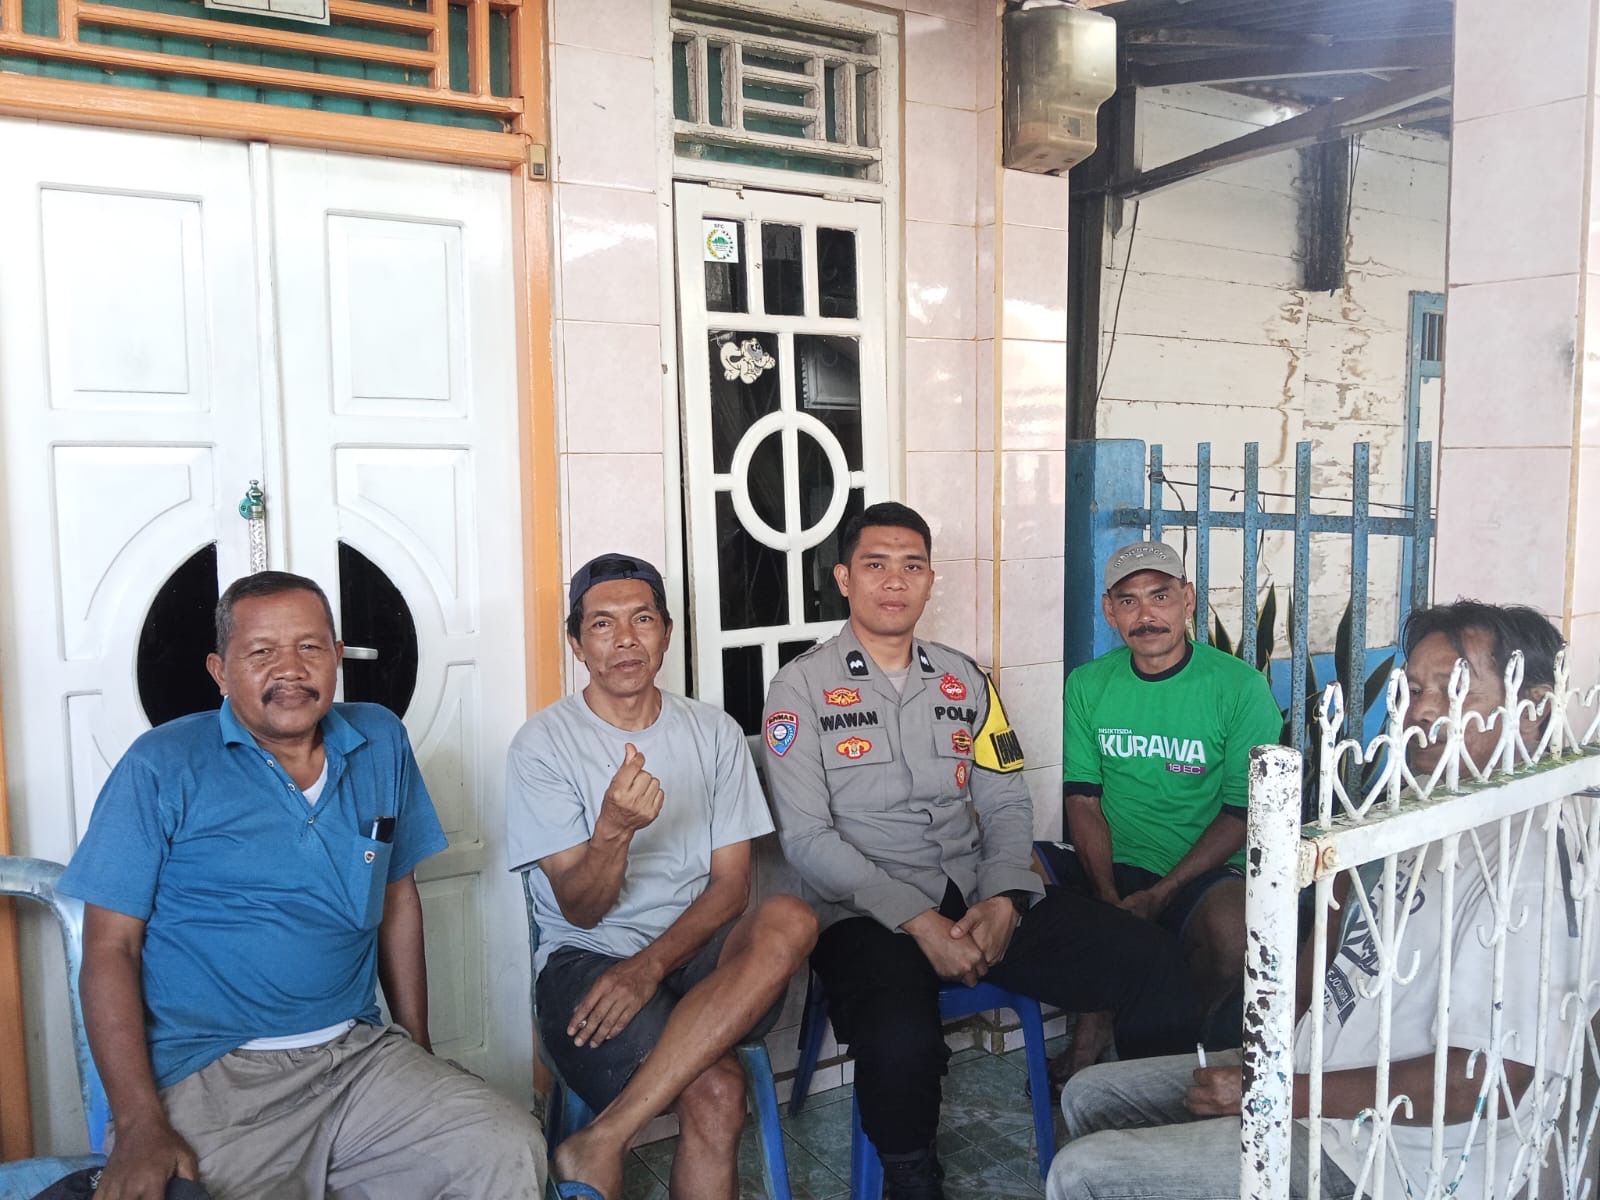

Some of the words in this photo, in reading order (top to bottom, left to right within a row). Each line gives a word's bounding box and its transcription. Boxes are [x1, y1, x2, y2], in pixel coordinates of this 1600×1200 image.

[820, 711, 878, 731] WAWAN
[1099, 733, 1207, 764] KURAWA
[1168, 763, 1181, 773] 18
